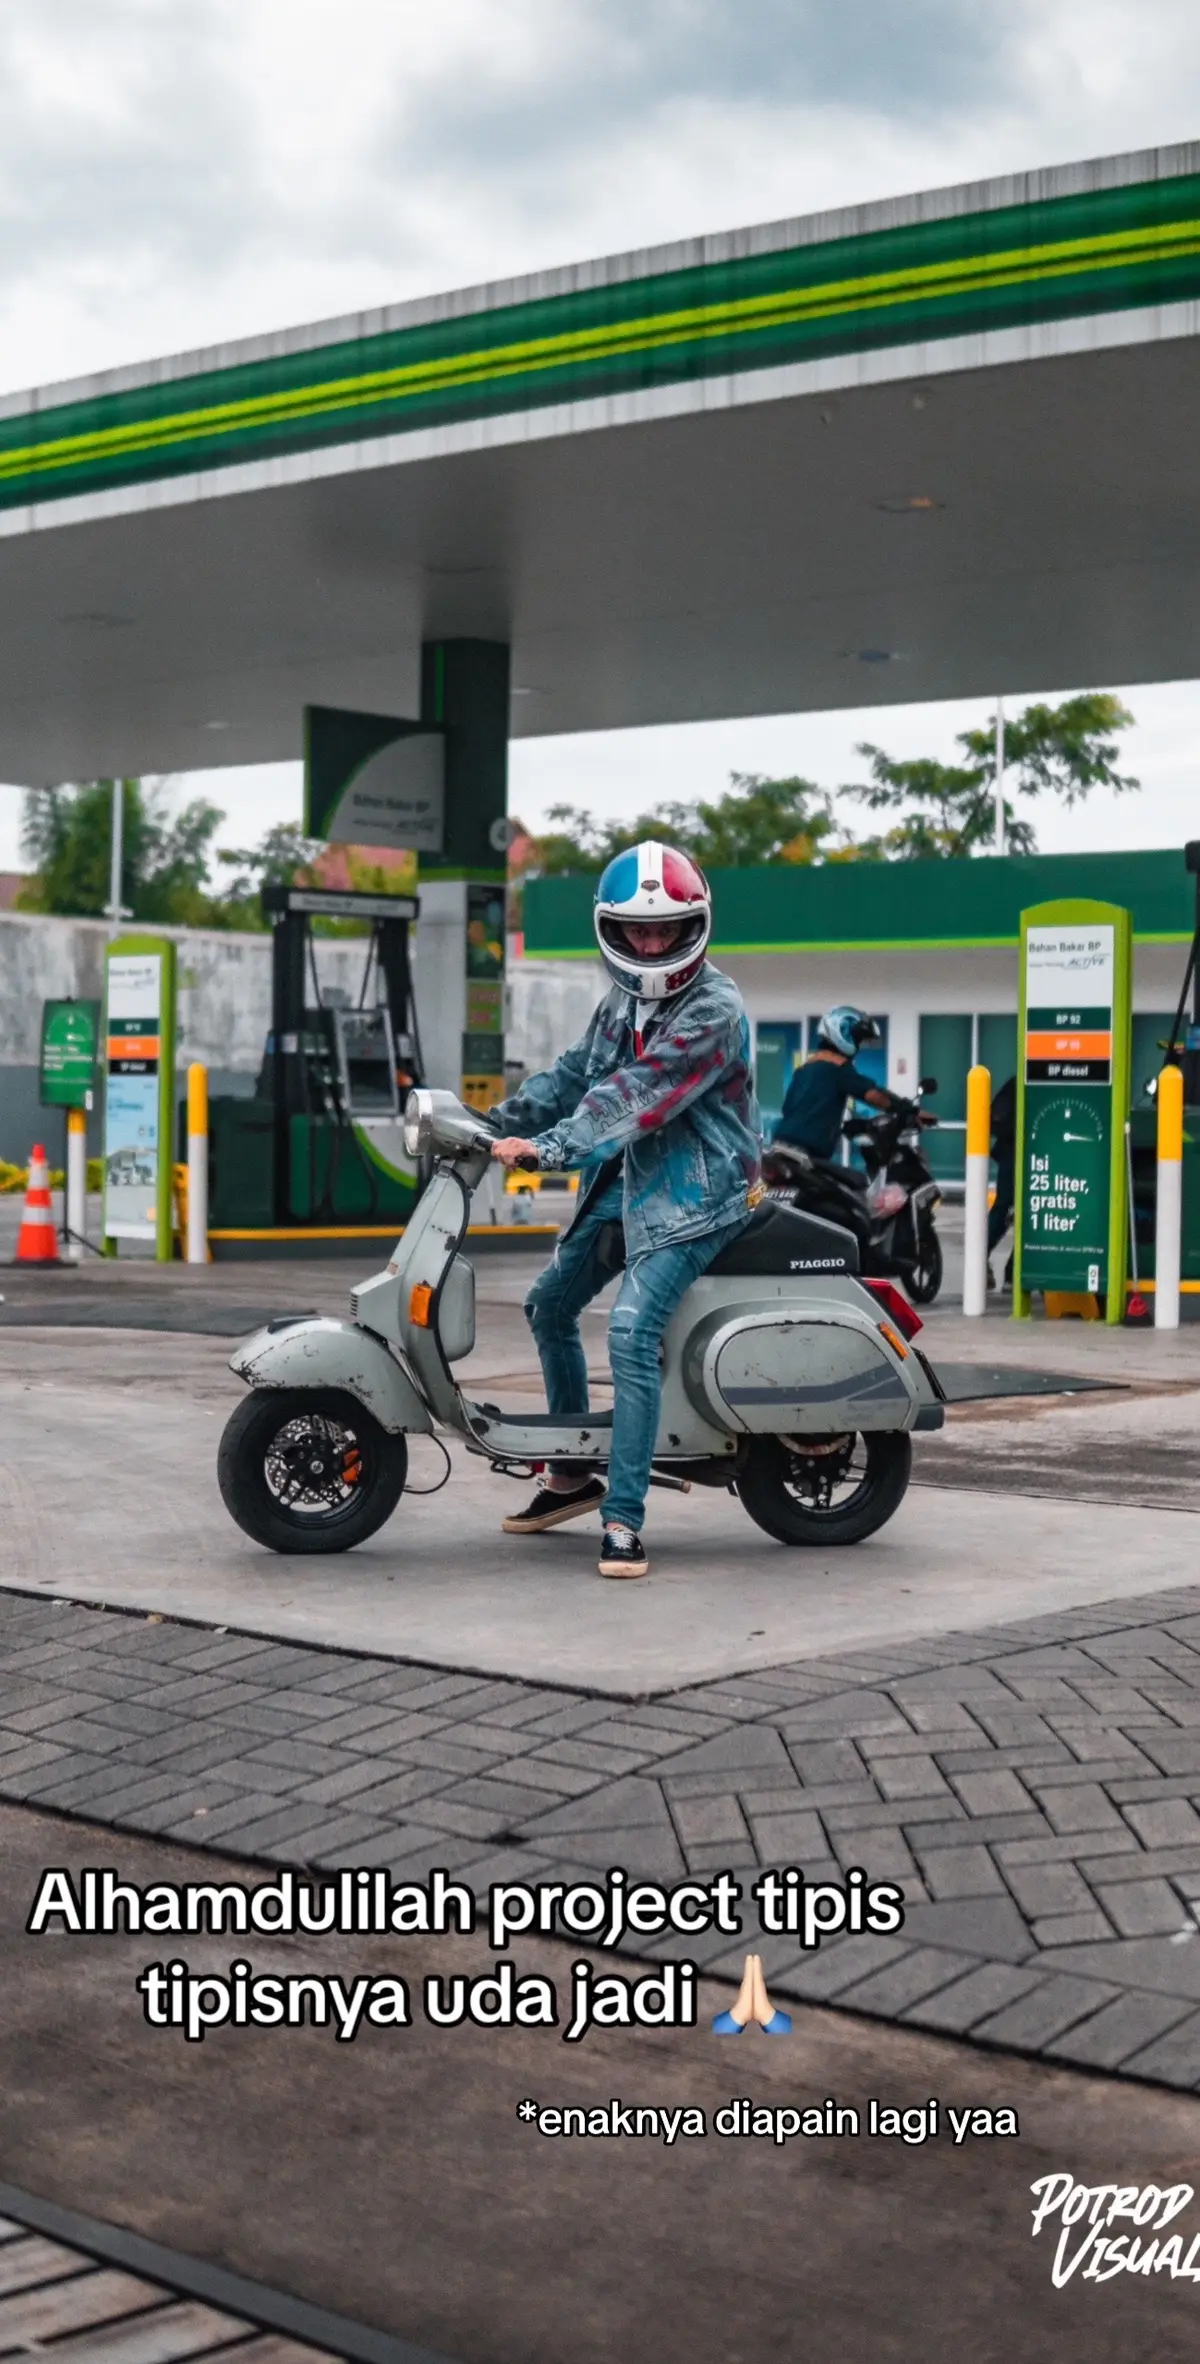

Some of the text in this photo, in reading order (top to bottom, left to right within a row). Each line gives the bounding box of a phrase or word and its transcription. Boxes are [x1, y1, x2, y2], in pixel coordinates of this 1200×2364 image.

[1055, 1014, 1068, 1025] BP
[1048, 1064, 1089, 1077] BP diesel
[1031, 1154, 1049, 1172] Isi
[1030, 1174, 1089, 1195] 25 liter,
[1030, 1193, 1077, 1212] gratis
[1031, 1213, 1038, 1231] 1
[790, 1258, 846, 1270] PIAGGIO
